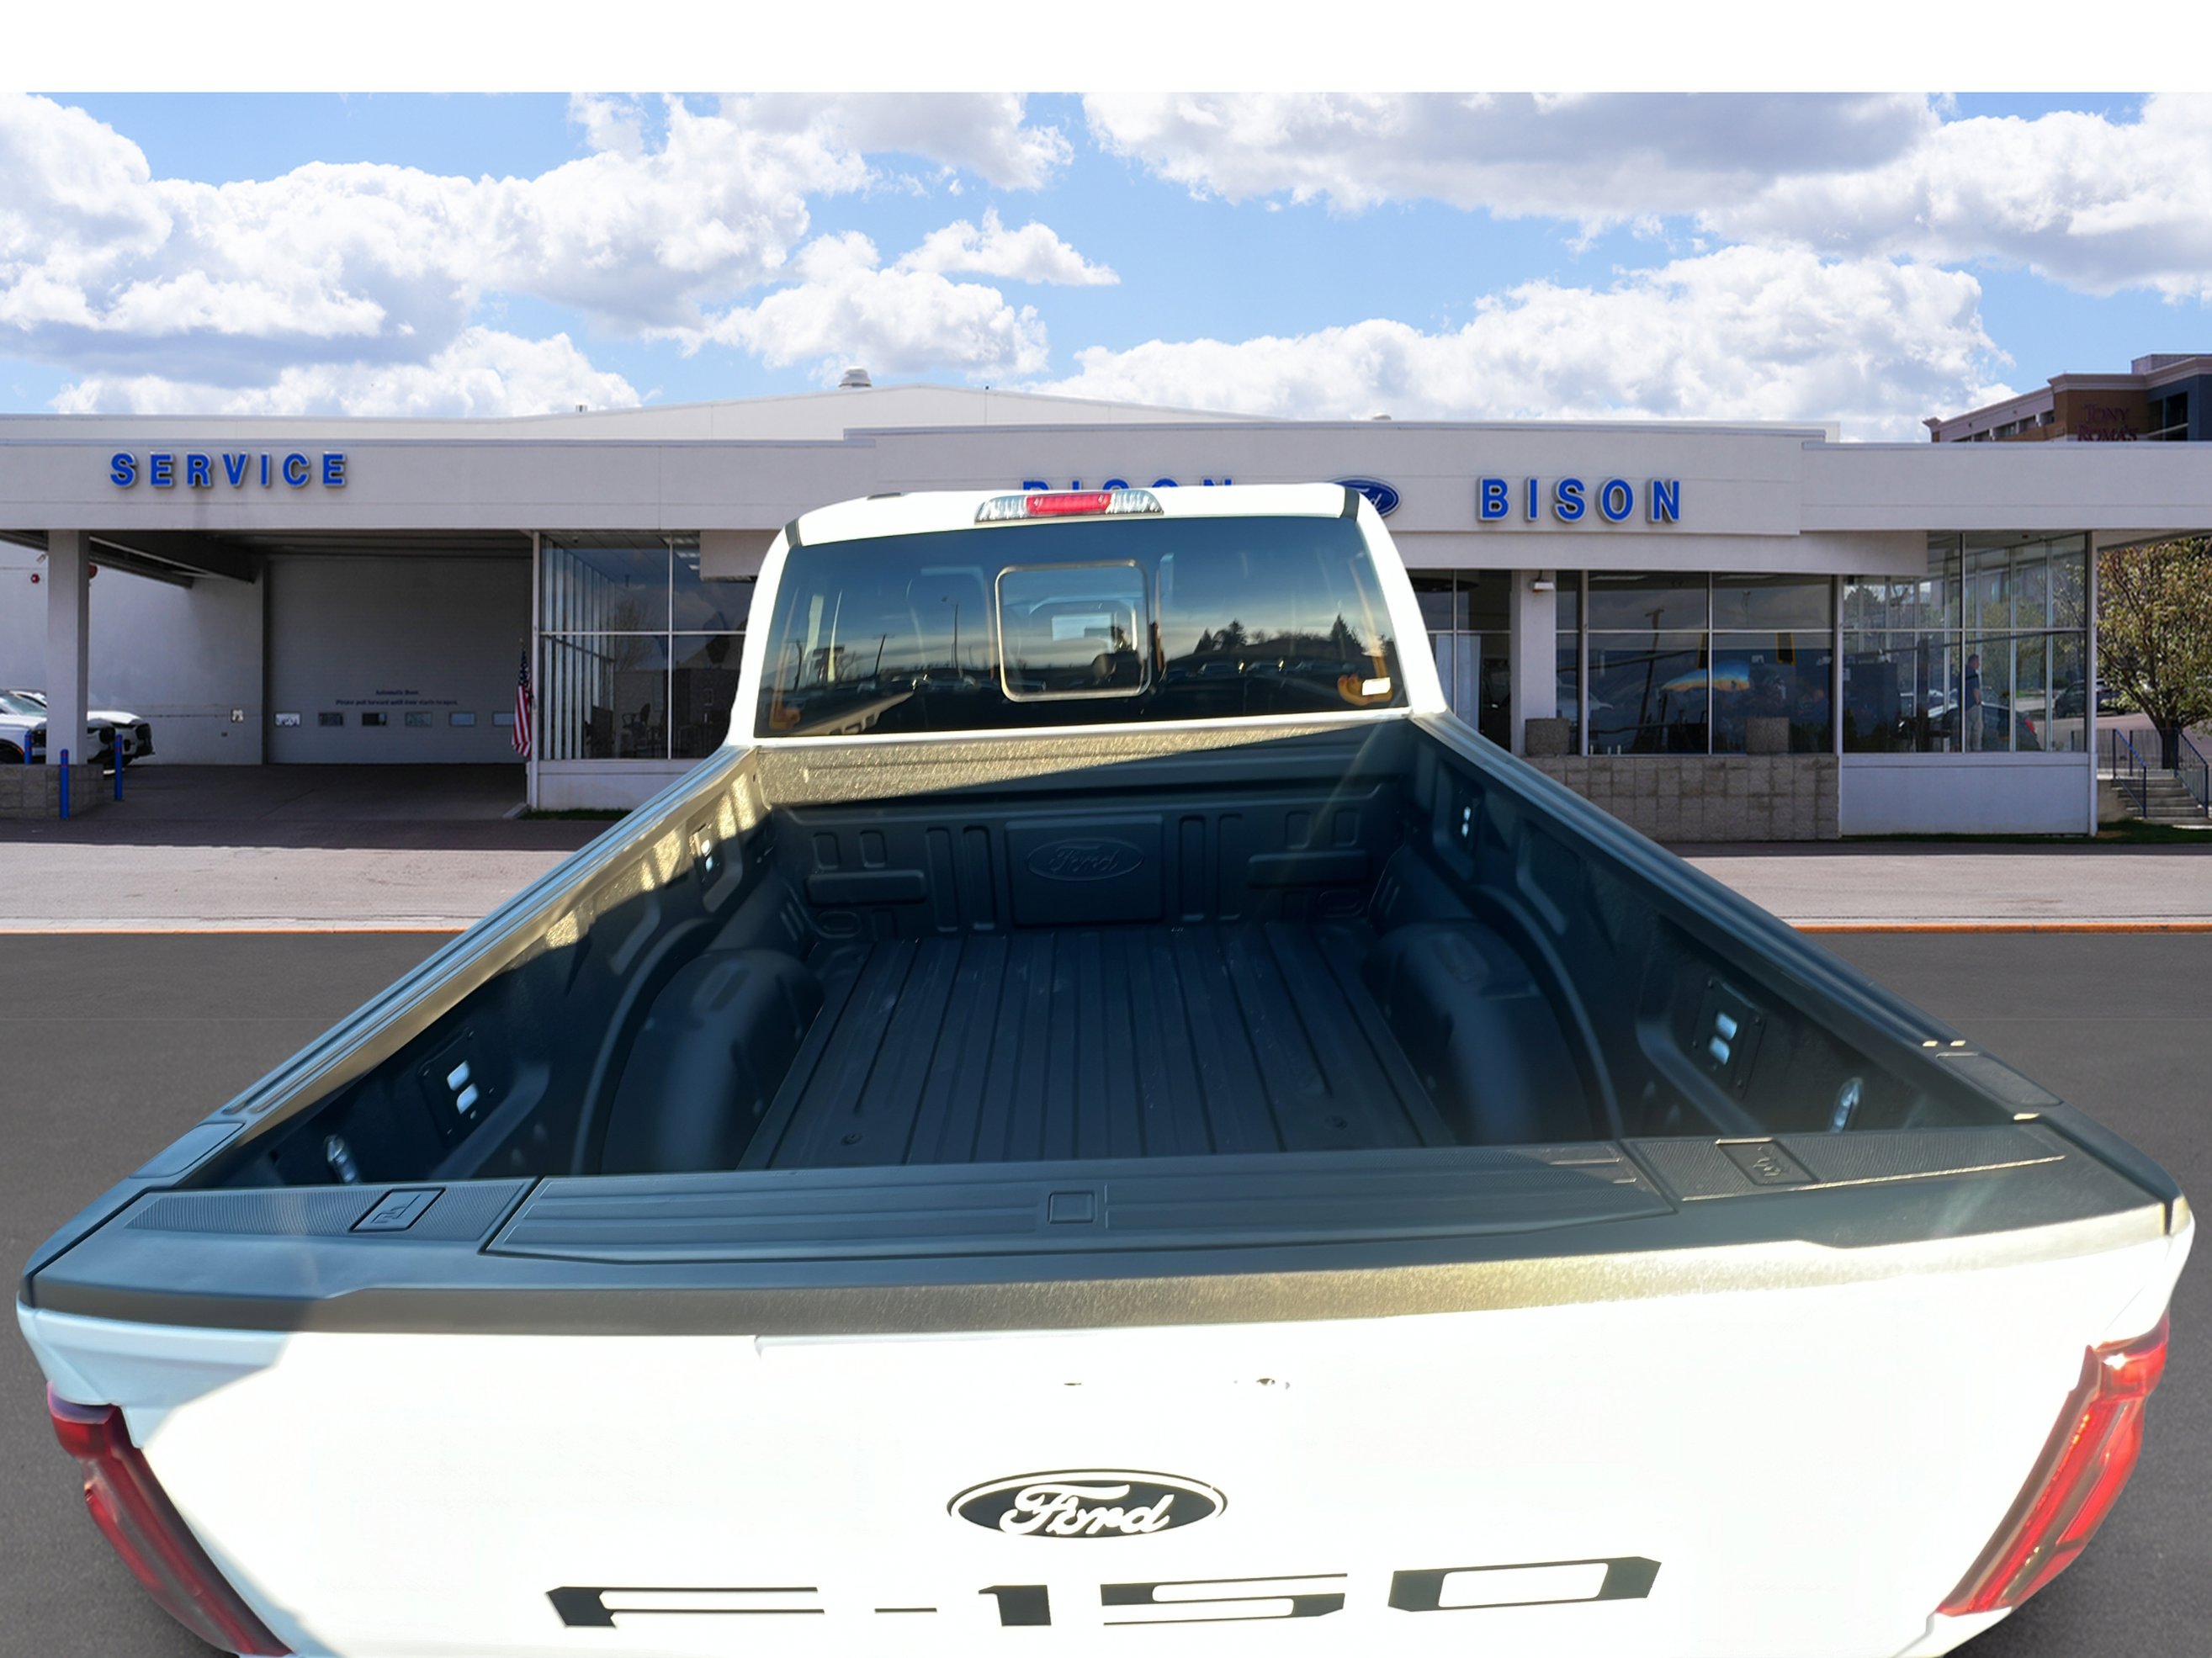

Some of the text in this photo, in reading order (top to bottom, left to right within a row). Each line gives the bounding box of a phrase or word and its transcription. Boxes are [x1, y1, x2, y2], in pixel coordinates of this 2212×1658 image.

[2080, 404, 2130, 424] TONY
[109, 451, 347, 488] SERVICE
[1477, 477, 1681, 522] BISON
[1048, 844, 1121, 872] Ford
[999, 1483, 1175, 1536] Ford
[544, 1555, 1663, 1629] F-150
